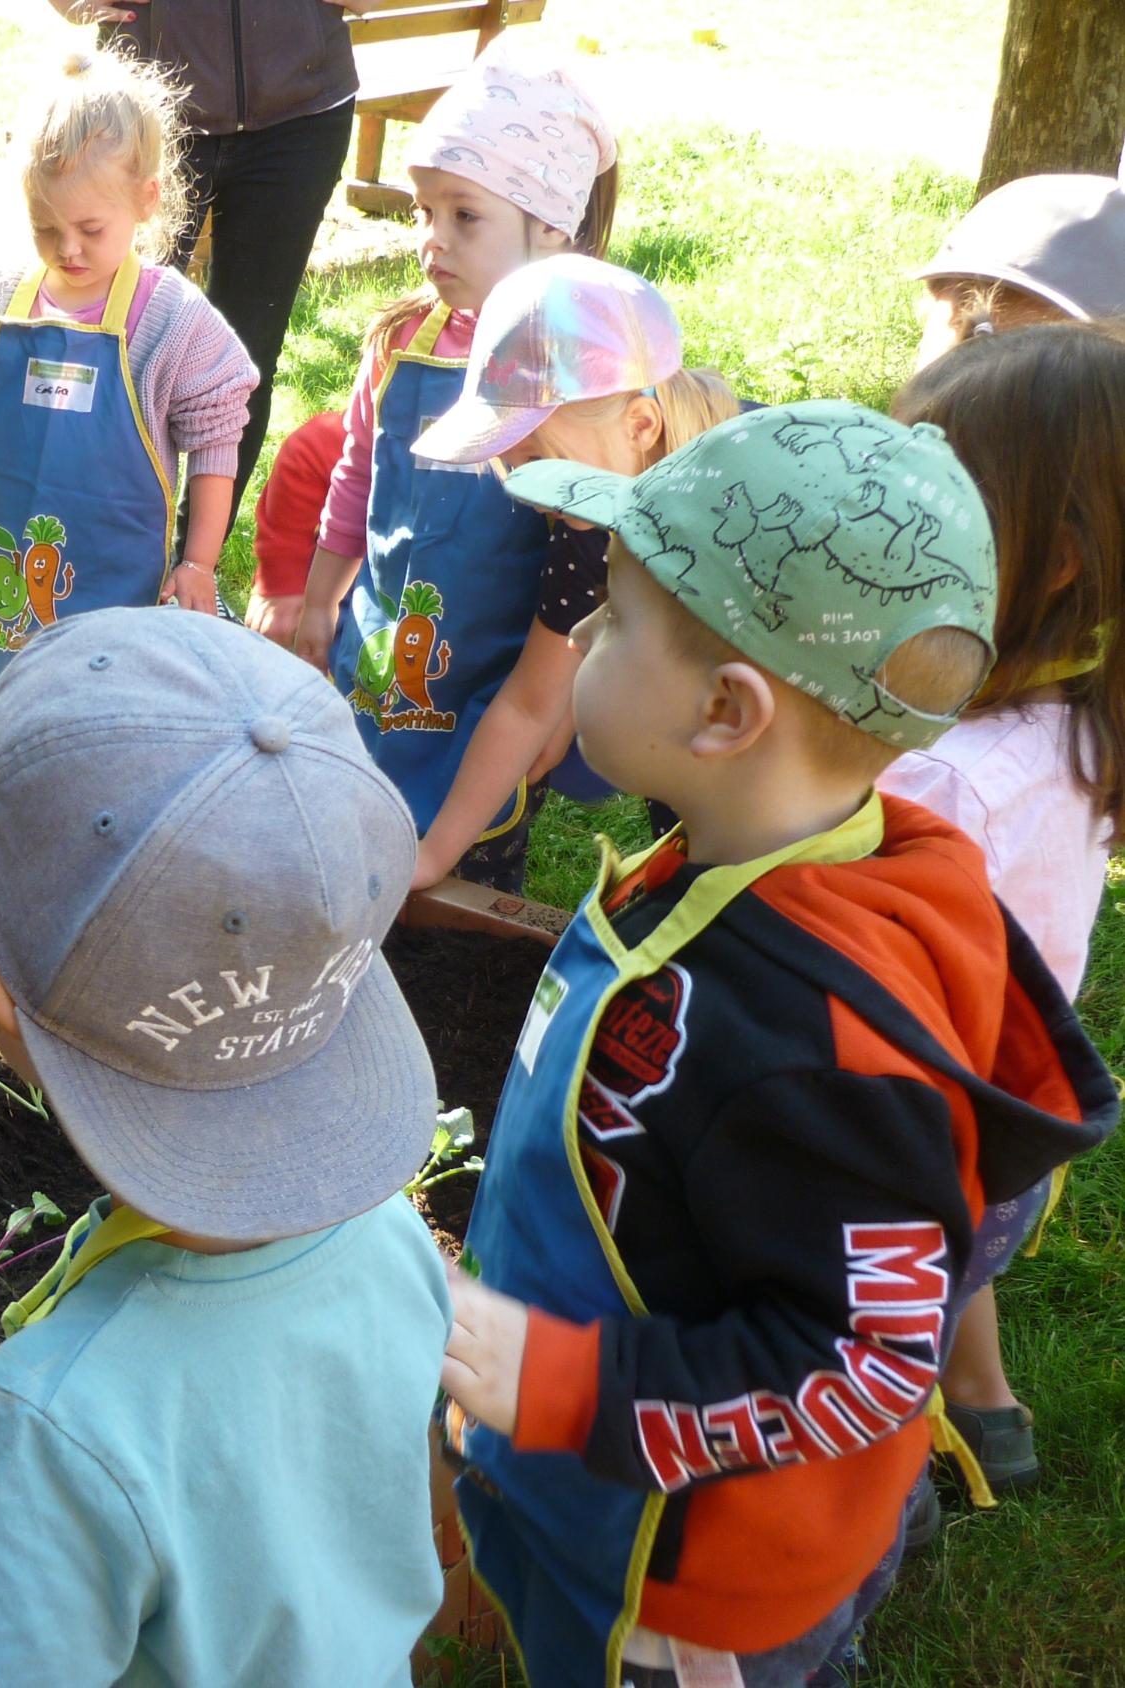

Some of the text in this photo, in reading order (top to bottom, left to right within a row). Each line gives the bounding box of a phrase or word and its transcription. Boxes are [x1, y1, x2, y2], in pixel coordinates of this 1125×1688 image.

[822, 612, 854, 626] wild
[821, 632, 835, 643] to
[842, 629, 881, 644] LOVE
[126, 964, 274, 1052] NEW
[215, 1011, 324, 1061] STATE
